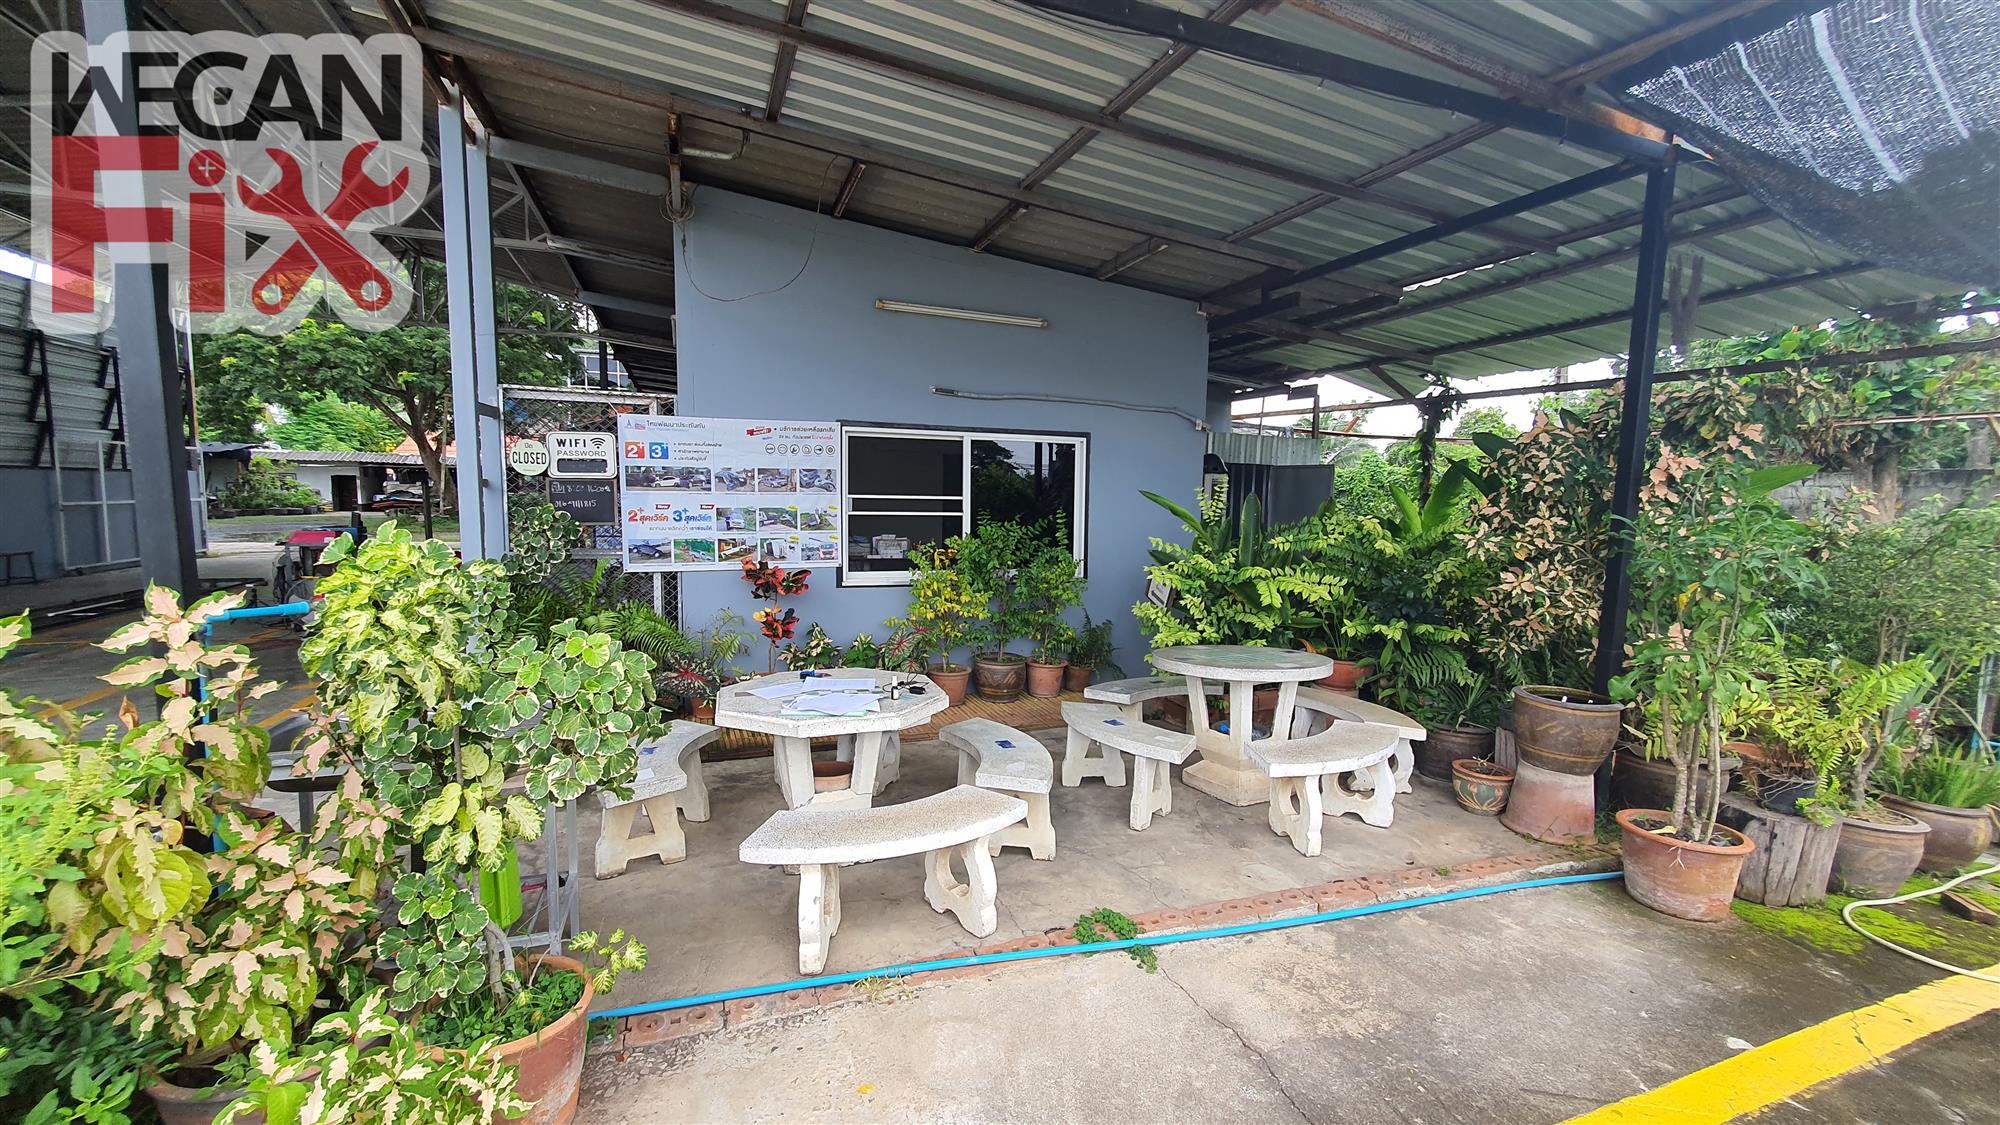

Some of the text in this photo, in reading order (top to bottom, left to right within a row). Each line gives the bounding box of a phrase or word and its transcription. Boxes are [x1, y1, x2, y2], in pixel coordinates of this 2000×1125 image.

[556, 438, 587, 448] WIFI
[512, 451, 547, 465] CLOSED
[556, 449, 607, 457] PASSWORD
